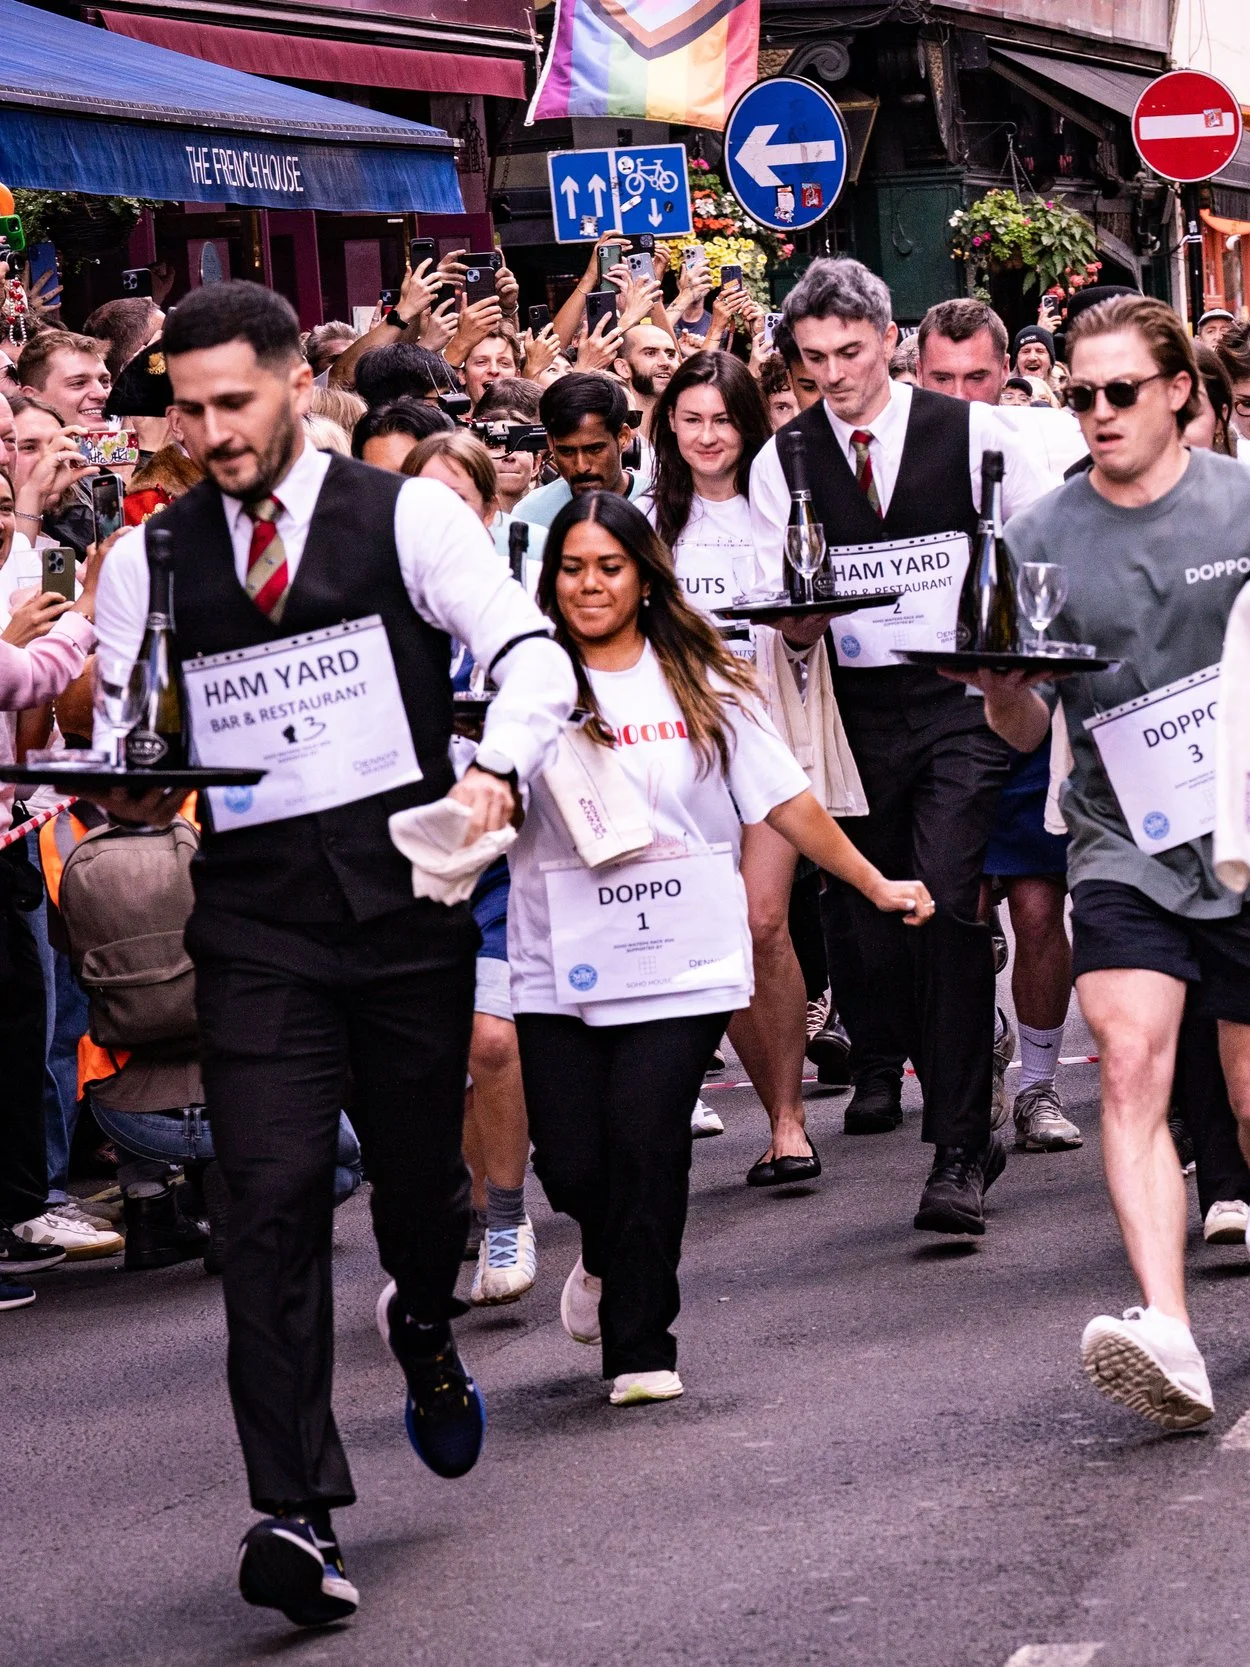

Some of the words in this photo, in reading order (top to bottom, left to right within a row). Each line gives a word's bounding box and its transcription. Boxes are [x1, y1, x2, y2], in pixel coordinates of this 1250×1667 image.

[185, 146, 212, 185] THE
[212, 147, 263, 188] FRENCH
[260, 153, 304, 192] HOUSE
[833, 561, 885, 582] HAM
[889, 551, 951, 576] YARD
[874, 576, 953, 595] RESTAURANT
[204, 671, 268, 707] HAM
[274, 649, 360, 690] YARD
[210, 713, 240, 733] BAR
[244, 712, 256, 726] &
[260, 681, 368, 722] RESTAURANT
[1187, 743, 1205, 763] 3
[598, 879, 682, 906] DOPPO
[636, 912, 650, 931] 1
